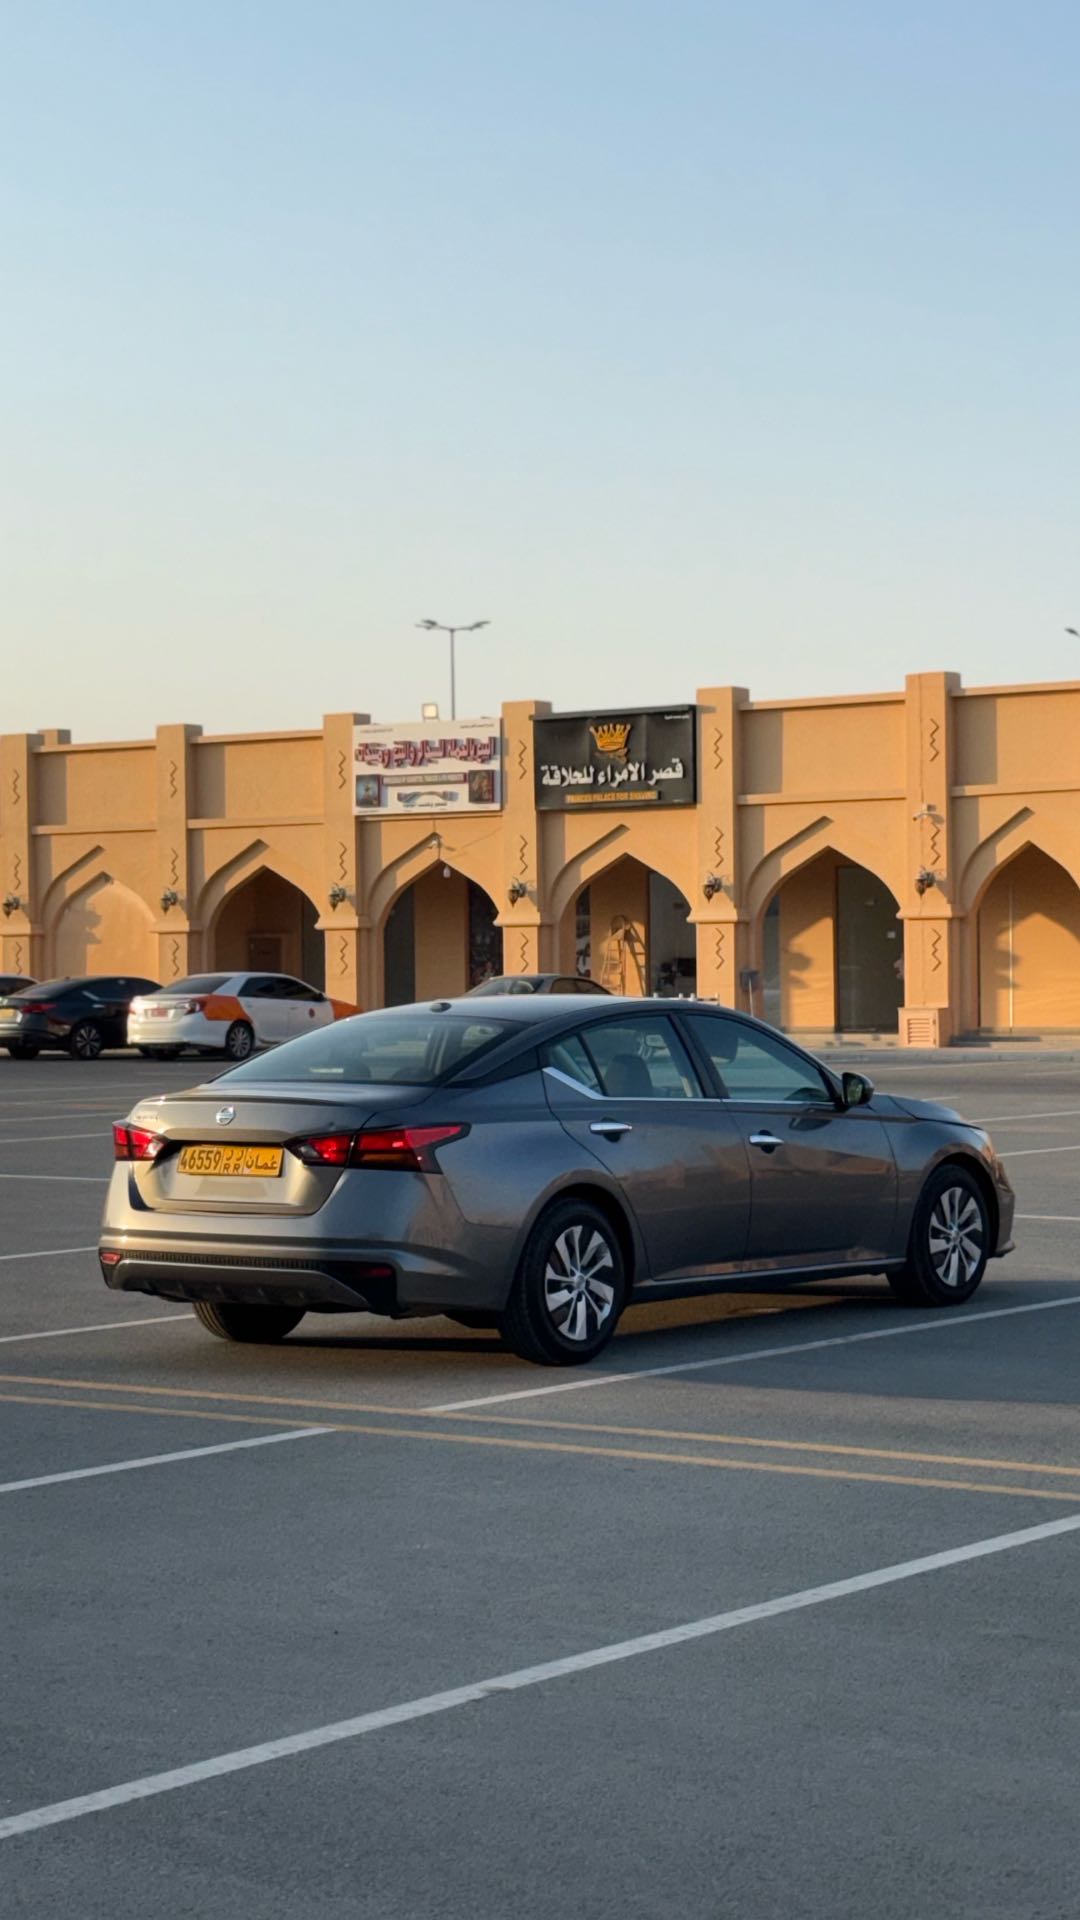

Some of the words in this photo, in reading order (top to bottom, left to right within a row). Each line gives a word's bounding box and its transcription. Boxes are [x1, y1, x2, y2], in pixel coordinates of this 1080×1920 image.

[540, 764, 595, 787] للحلاقة
[597, 761, 645, 788] الامراء
[648, 757, 684, 785] قصر
[180, 1148, 222, 1171] 46559
